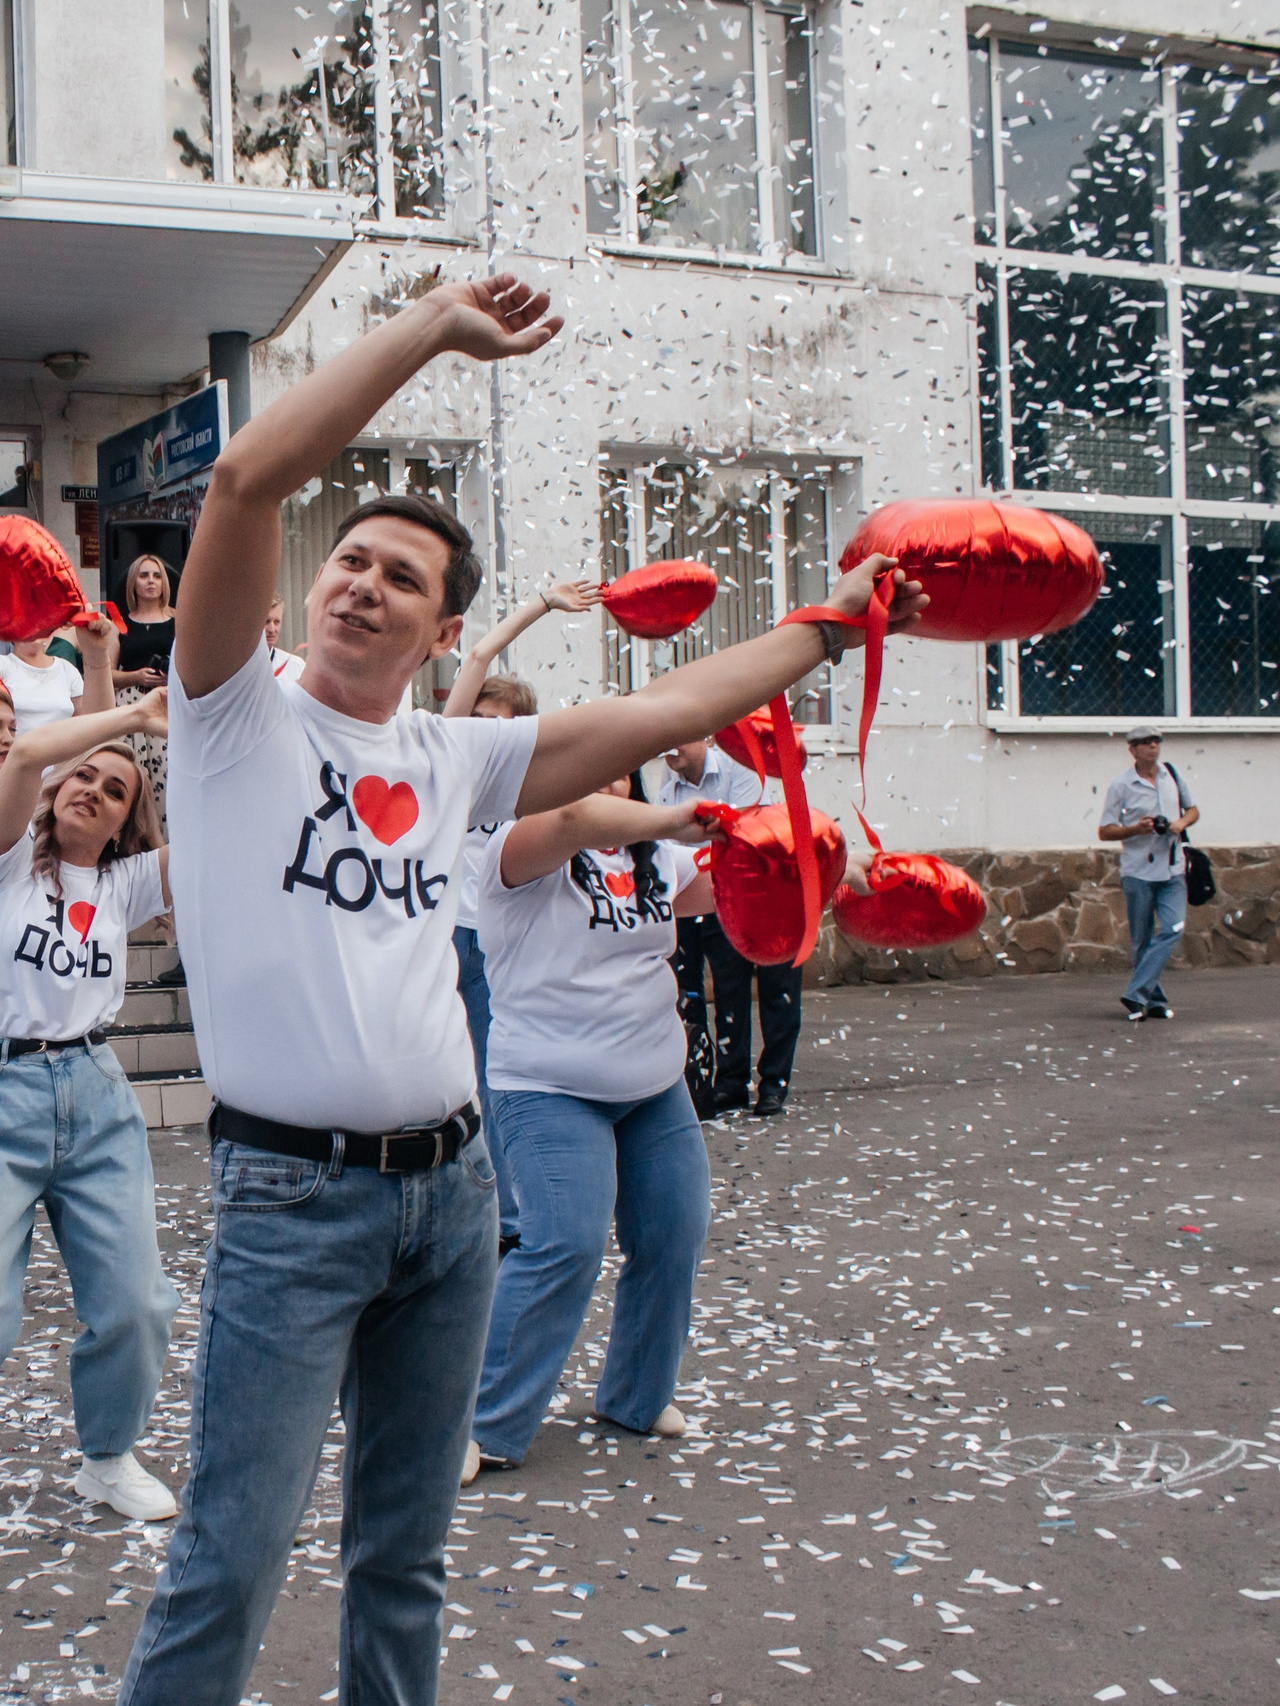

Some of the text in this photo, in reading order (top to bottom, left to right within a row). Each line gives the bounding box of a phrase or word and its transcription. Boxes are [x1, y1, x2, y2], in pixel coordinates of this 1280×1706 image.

[314, 760, 358, 832] Я
[282, 815, 449, 919] ДОЧЬ
[13, 923, 113, 979] ДОЧЬ
